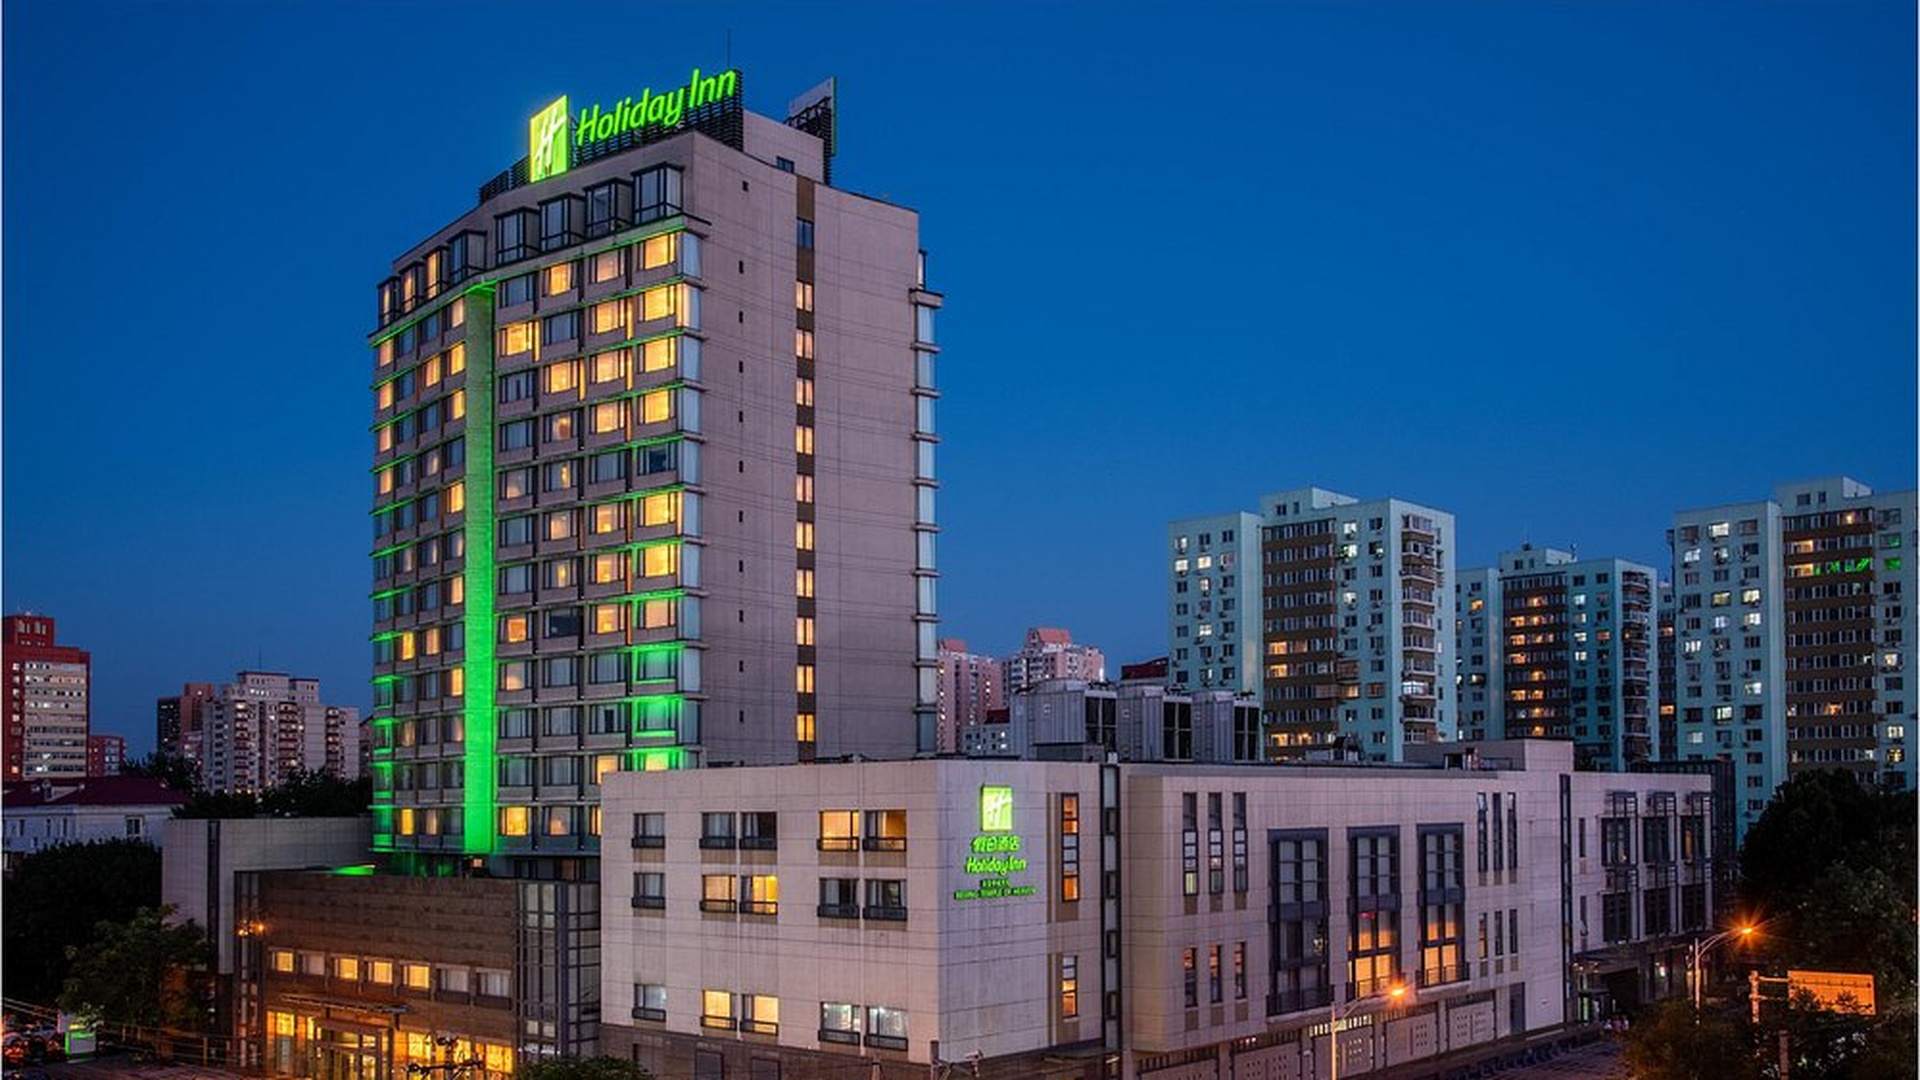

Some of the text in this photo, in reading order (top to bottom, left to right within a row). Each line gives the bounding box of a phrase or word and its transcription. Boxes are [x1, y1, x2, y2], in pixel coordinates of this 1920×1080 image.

[576, 68, 736, 146] Holiday Inn
[966, 855, 1026, 875] Holiday Inn
